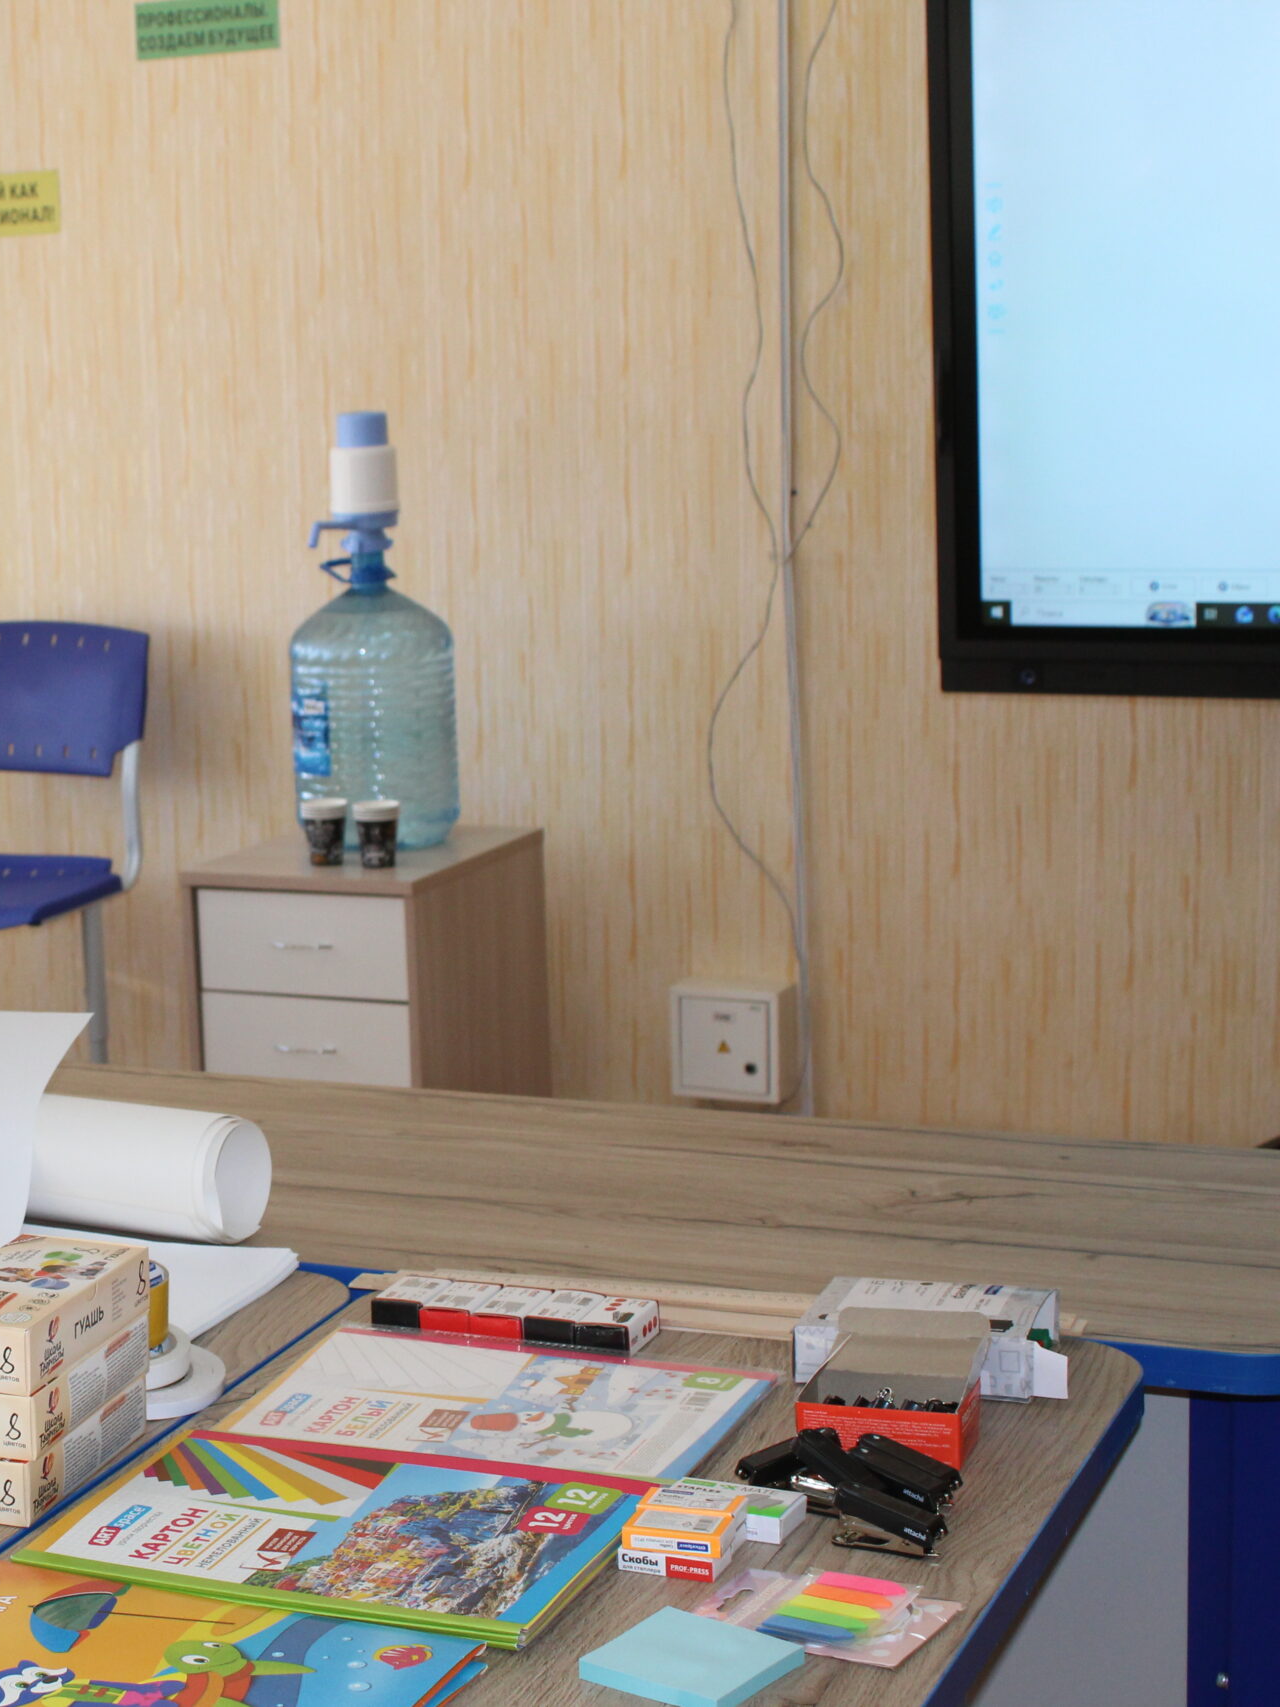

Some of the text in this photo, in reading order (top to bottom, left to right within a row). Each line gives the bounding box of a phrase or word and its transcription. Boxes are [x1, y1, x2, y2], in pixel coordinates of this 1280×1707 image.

[10, 182, 39, 198] КАК
[74, 1305, 105, 1340] ГУАШЬ
[304, 1396, 361, 1433] КАРТОН
[335, 1399, 394, 1437] БЕЛЫЙ
[557, 1488, 598, 1505] 12
[128, 1507, 209, 1560] КАРТОН
[528, 1511, 566, 1527] 12
[162, 1513, 241, 1565] ЦВЕТНОЙ
[195, 1517, 263, 1568] НЕМЕЛОВАННЫЙ
[621, 1553, 659, 1567] Скобы
[670, 1563, 710, 1576] PROF-PRESS
